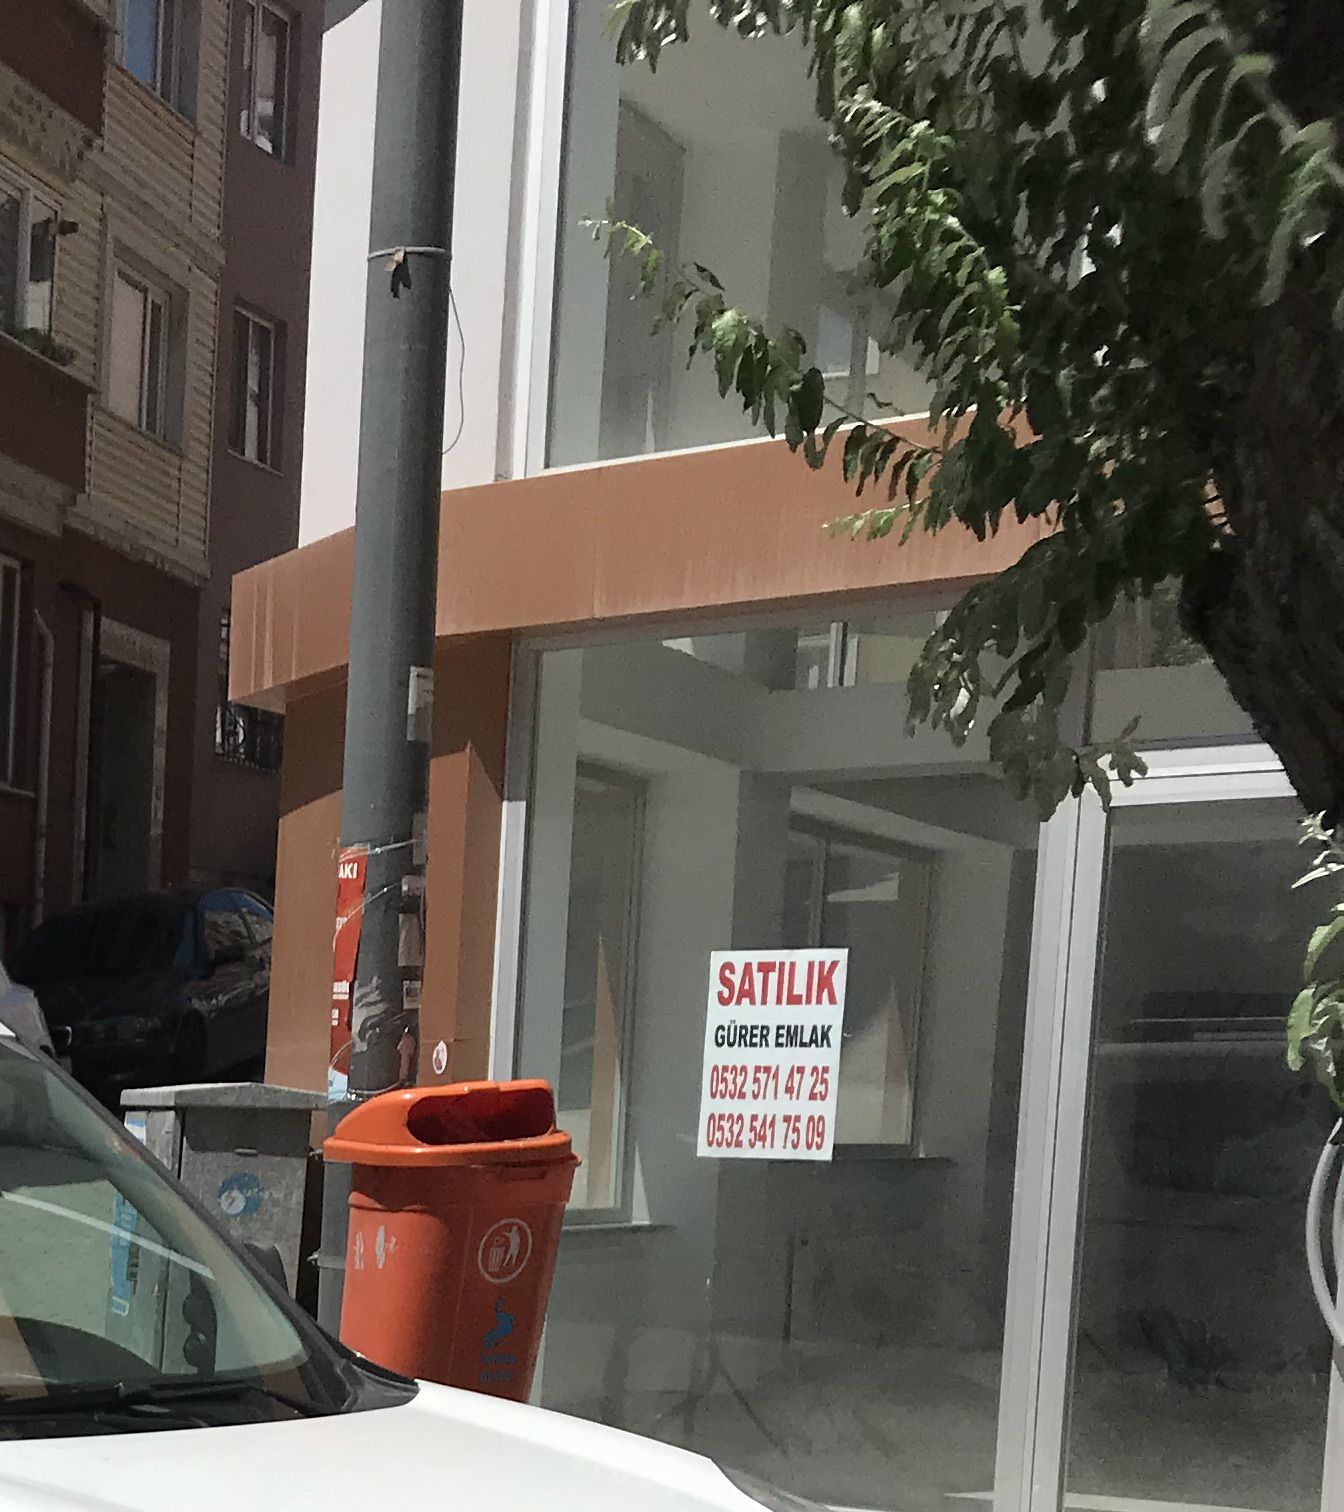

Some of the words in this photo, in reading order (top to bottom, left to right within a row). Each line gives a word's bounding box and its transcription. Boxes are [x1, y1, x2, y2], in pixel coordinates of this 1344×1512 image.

[717, 960, 840, 1006] SATILIK
[714, 1019, 770, 1048] GÜRER
[775, 1024, 833, 1048] EMLAK
[710, 1065, 748, 1100] 0532
[752, 1065, 779, 1100] 571
[784, 1065, 806, 1101] 47
[808, 1065, 830, 1102] 25
[706, 1113, 745, 1148] 0532
[748, 1113, 776, 1149] 541
[782, 1114, 802, 1150] 75
[805, 1115, 826, 1151] 09
